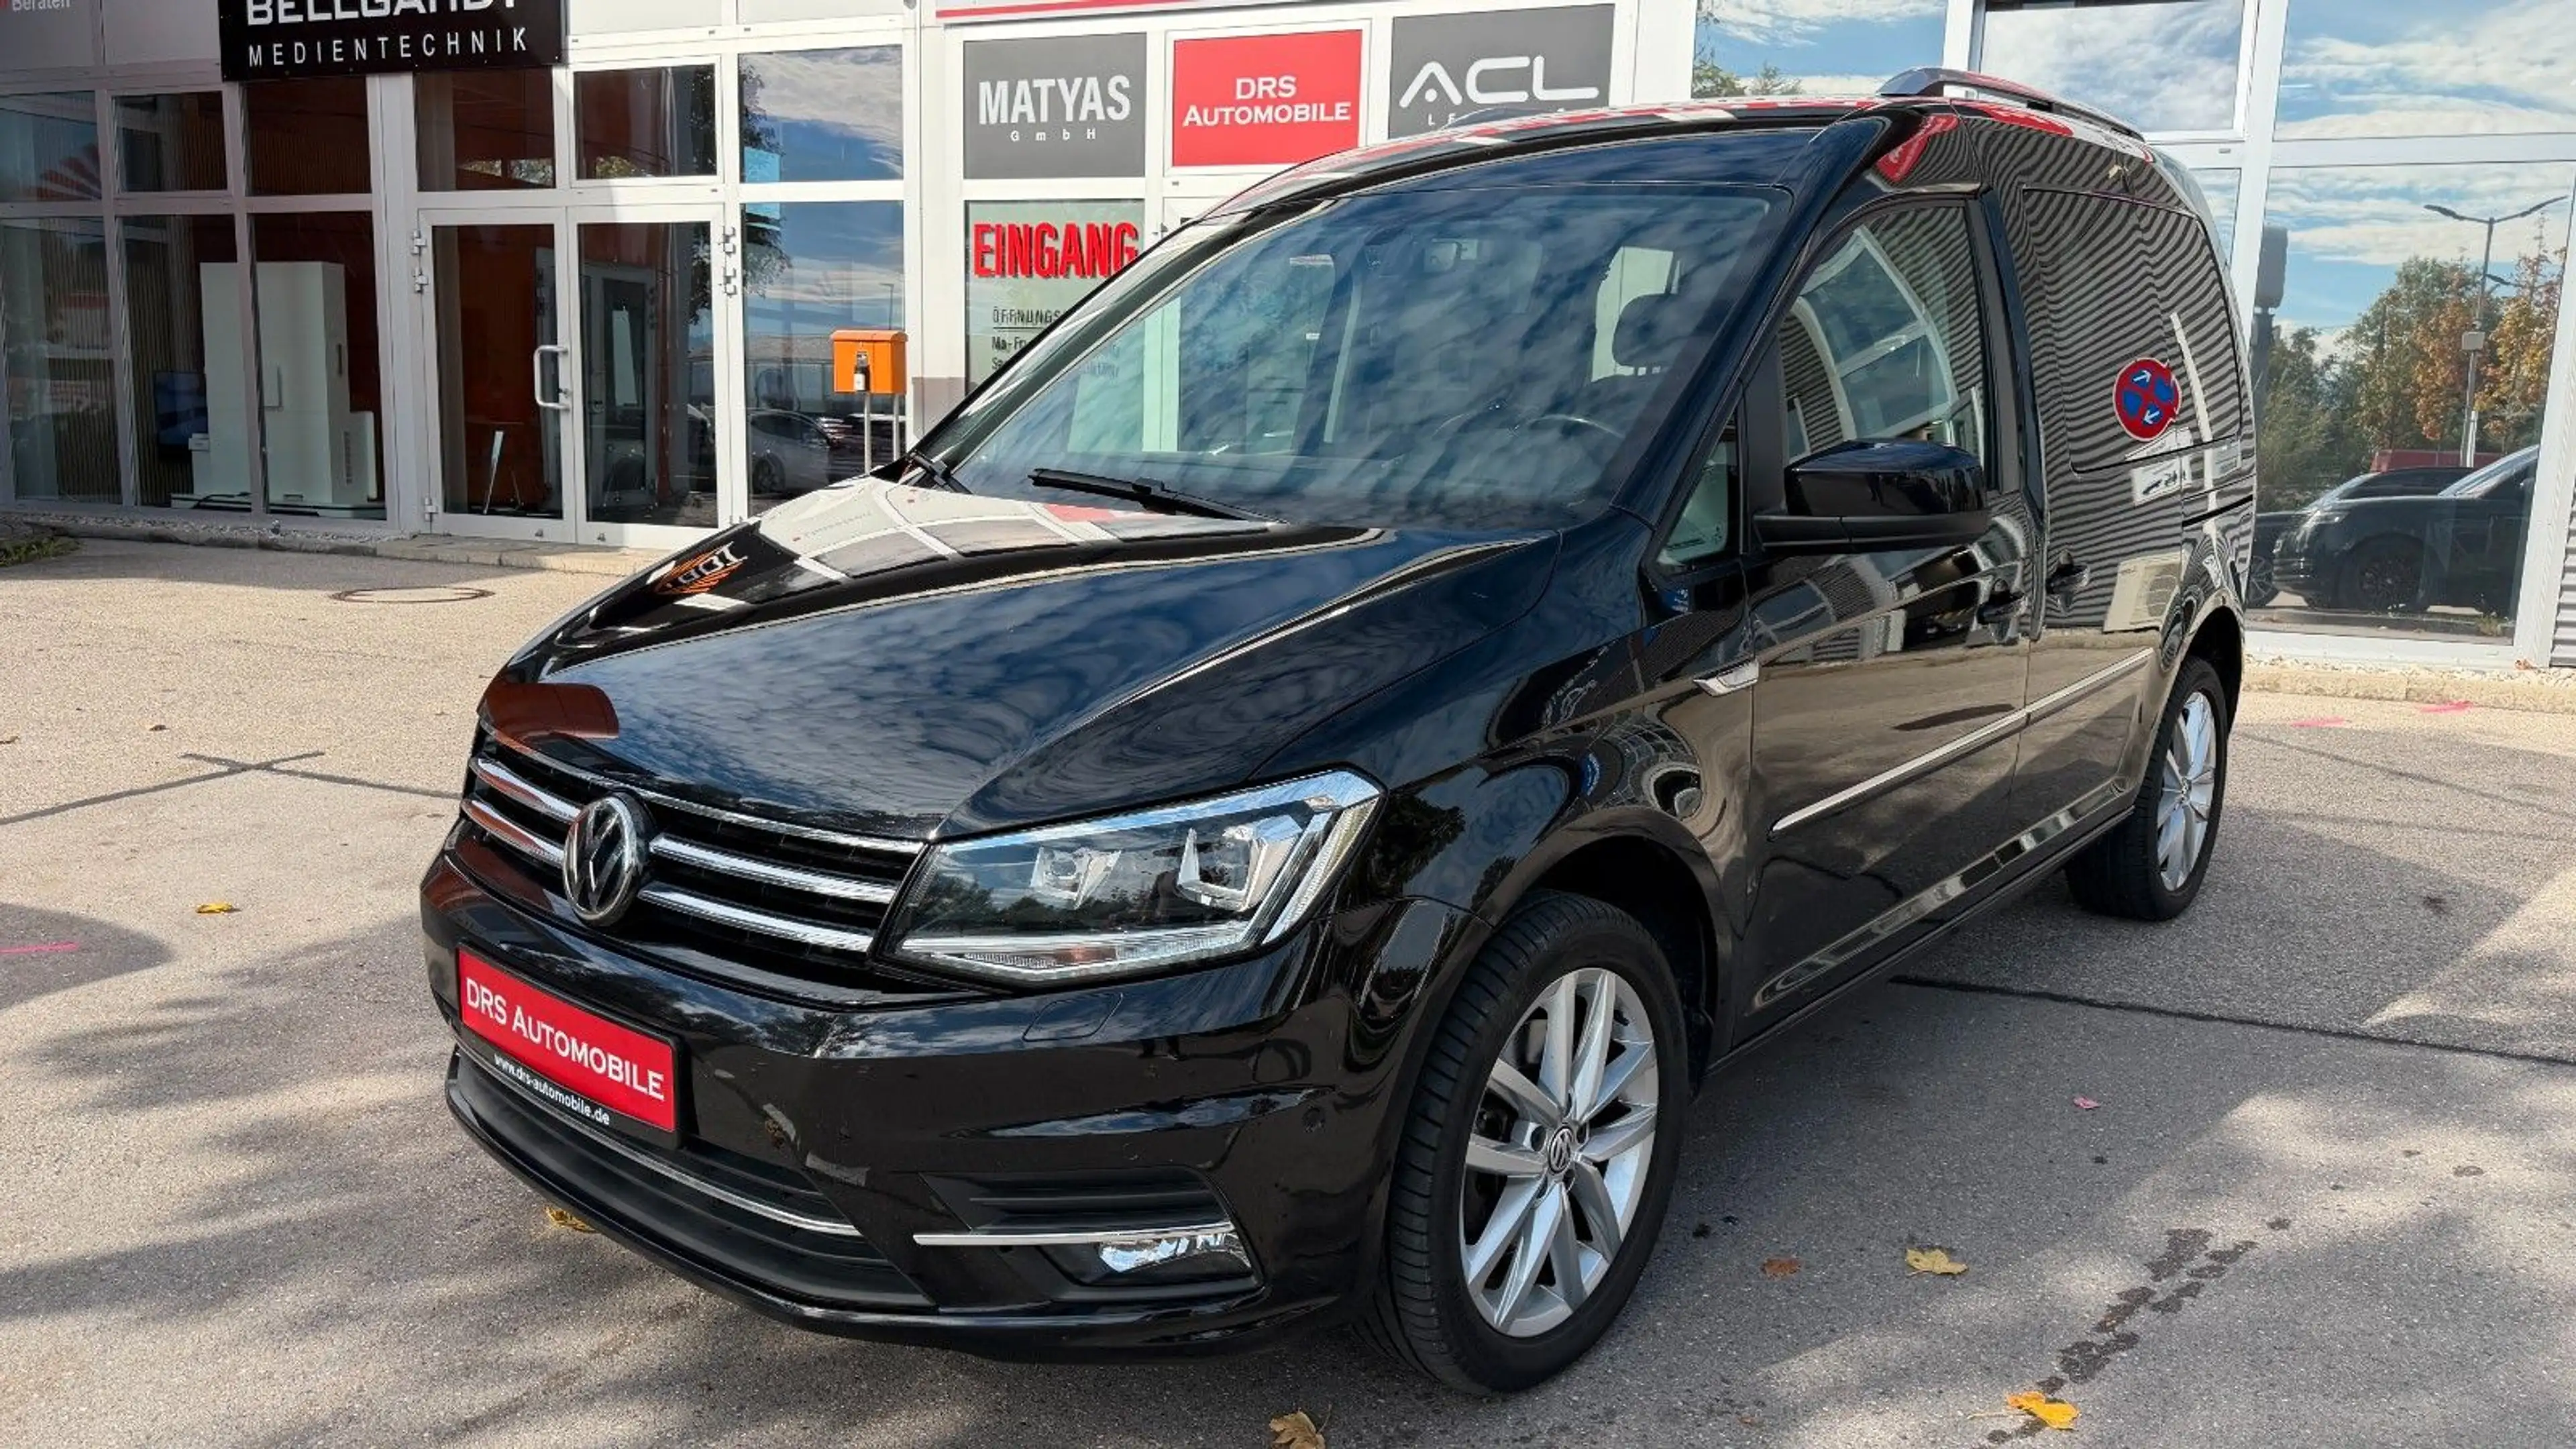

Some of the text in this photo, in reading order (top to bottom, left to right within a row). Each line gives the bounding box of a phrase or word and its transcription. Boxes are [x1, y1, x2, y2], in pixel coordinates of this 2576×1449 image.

[249, 28, 526, 66] MEDIENTECHNIK
[979, 74, 1131, 125] MATYAS
[1236, 76, 1297, 100] DRS
[1399, 55, 1599, 107] ACL
[1182, 101, 1351, 127] AUTOMOBILE
[973, 222, 1139, 279] EINGANG
[993, 306, 1064, 323] ÖFFNUNGS
[466, 977, 665, 1102] DRS AUTOMOBILE
[494, 1053, 610, 1125] www.drs-automobile.de
